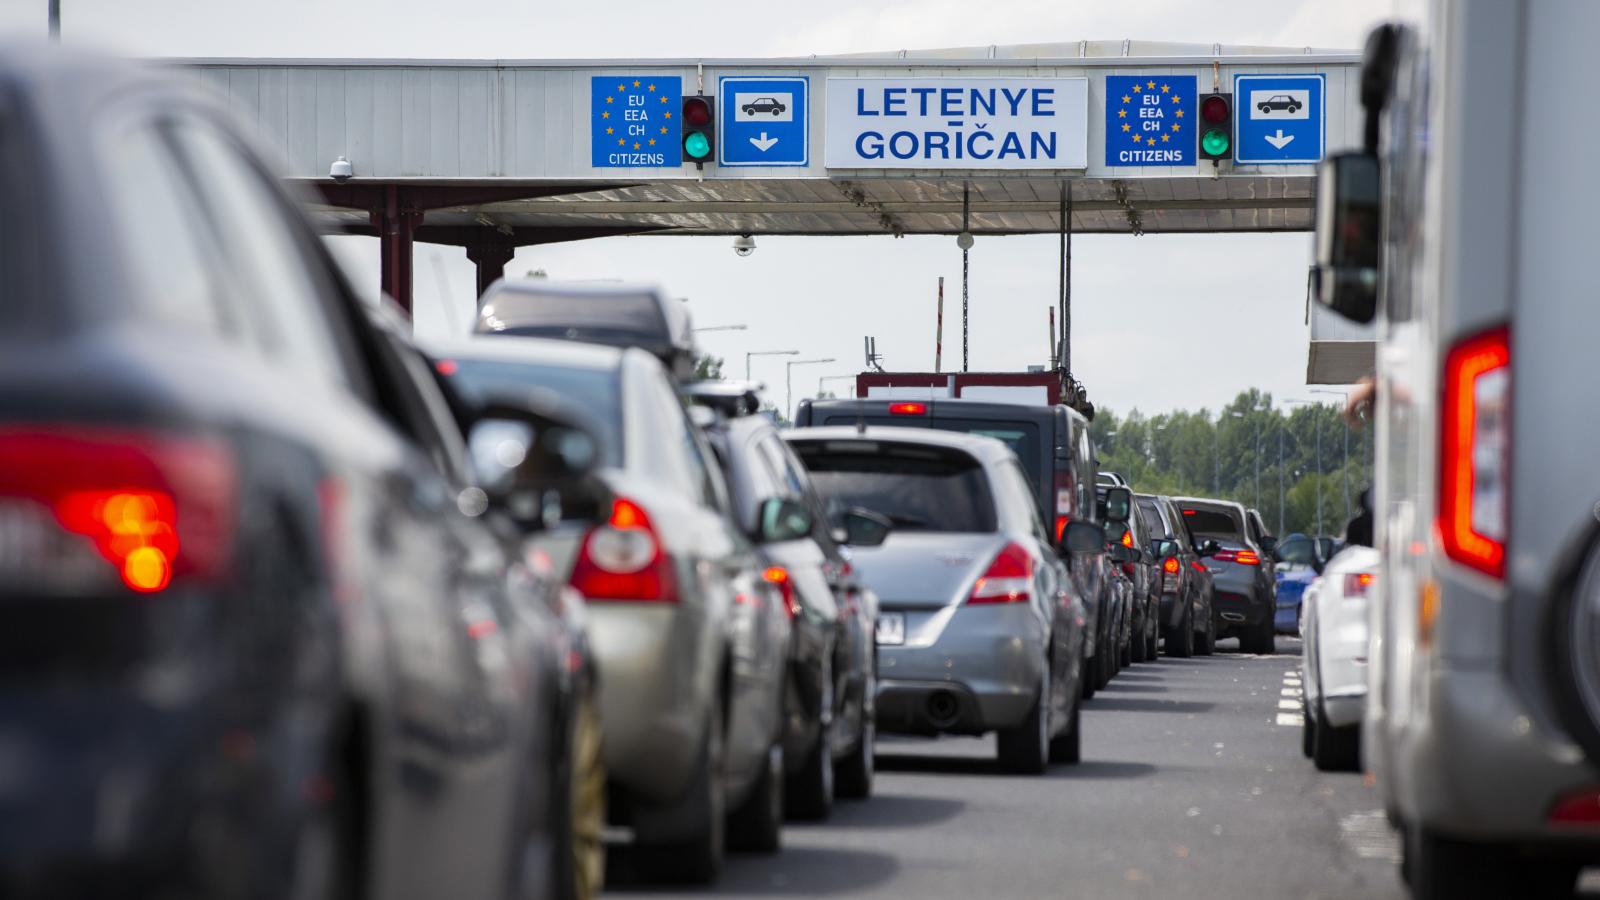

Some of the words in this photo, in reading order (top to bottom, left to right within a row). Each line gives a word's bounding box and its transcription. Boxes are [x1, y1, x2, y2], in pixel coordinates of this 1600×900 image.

[628, 95, 645, 106] EU
[857, 87, 1056, 117] LETENYE
[1143, 94, 1160, 105] EU
[624, 109, 649, 121] EEA
[1139, 107, 1164, 118] EEA
[628, 124, 645, 136] CH
[1143, 120, 1160, 131] CH
[609, 153, 664, 165] CITIZENS
[1119, 150, 1183, 162] CITIZENS
